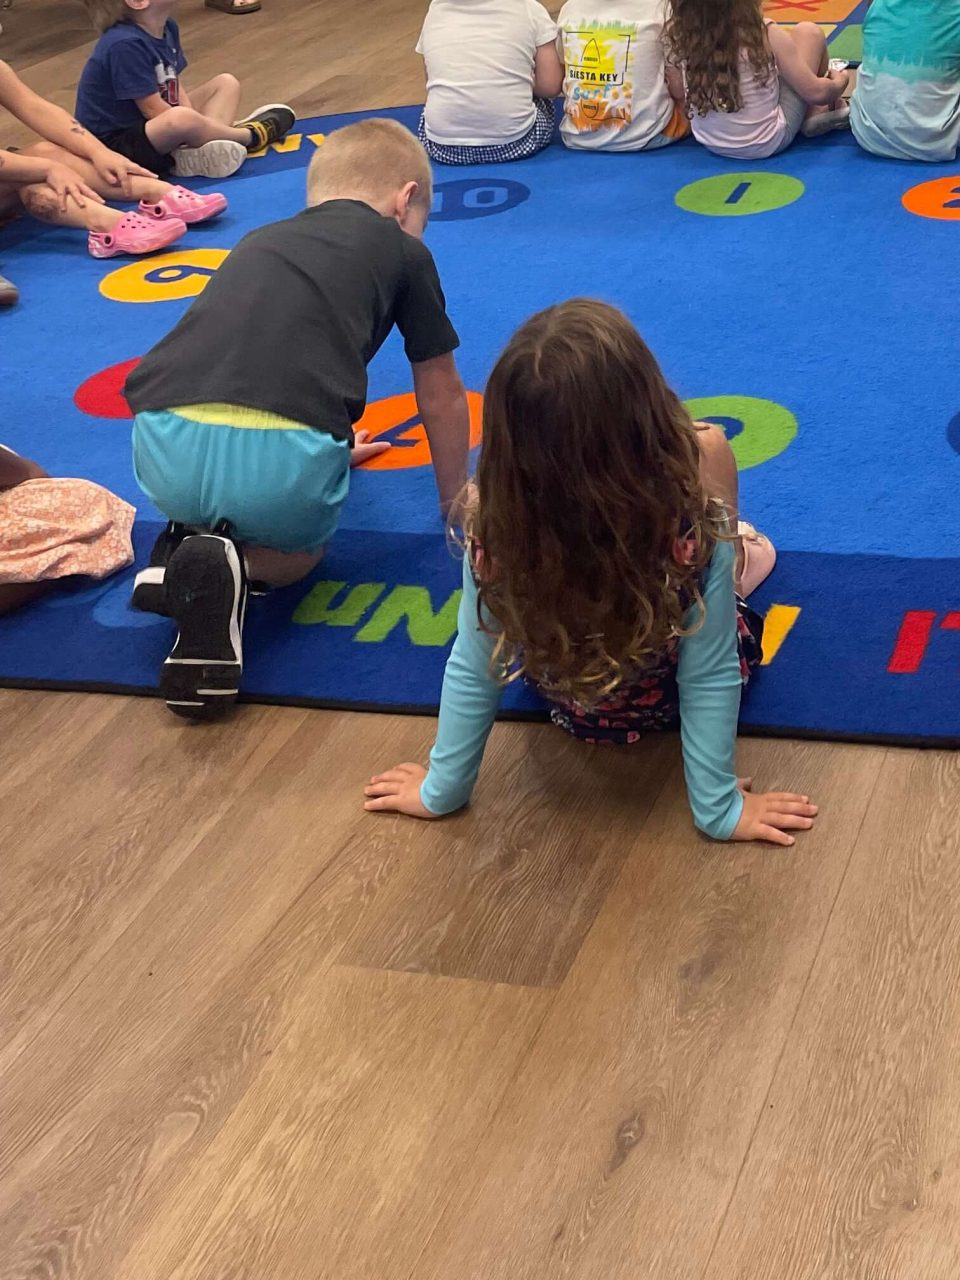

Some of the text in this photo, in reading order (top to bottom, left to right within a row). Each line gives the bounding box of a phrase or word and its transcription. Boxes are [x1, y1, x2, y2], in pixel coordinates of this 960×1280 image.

[569, 69, 618, 82] SIESTA KEY
[572, 83, 613, 101] Surf
[725, 182, 752, 204] 1
